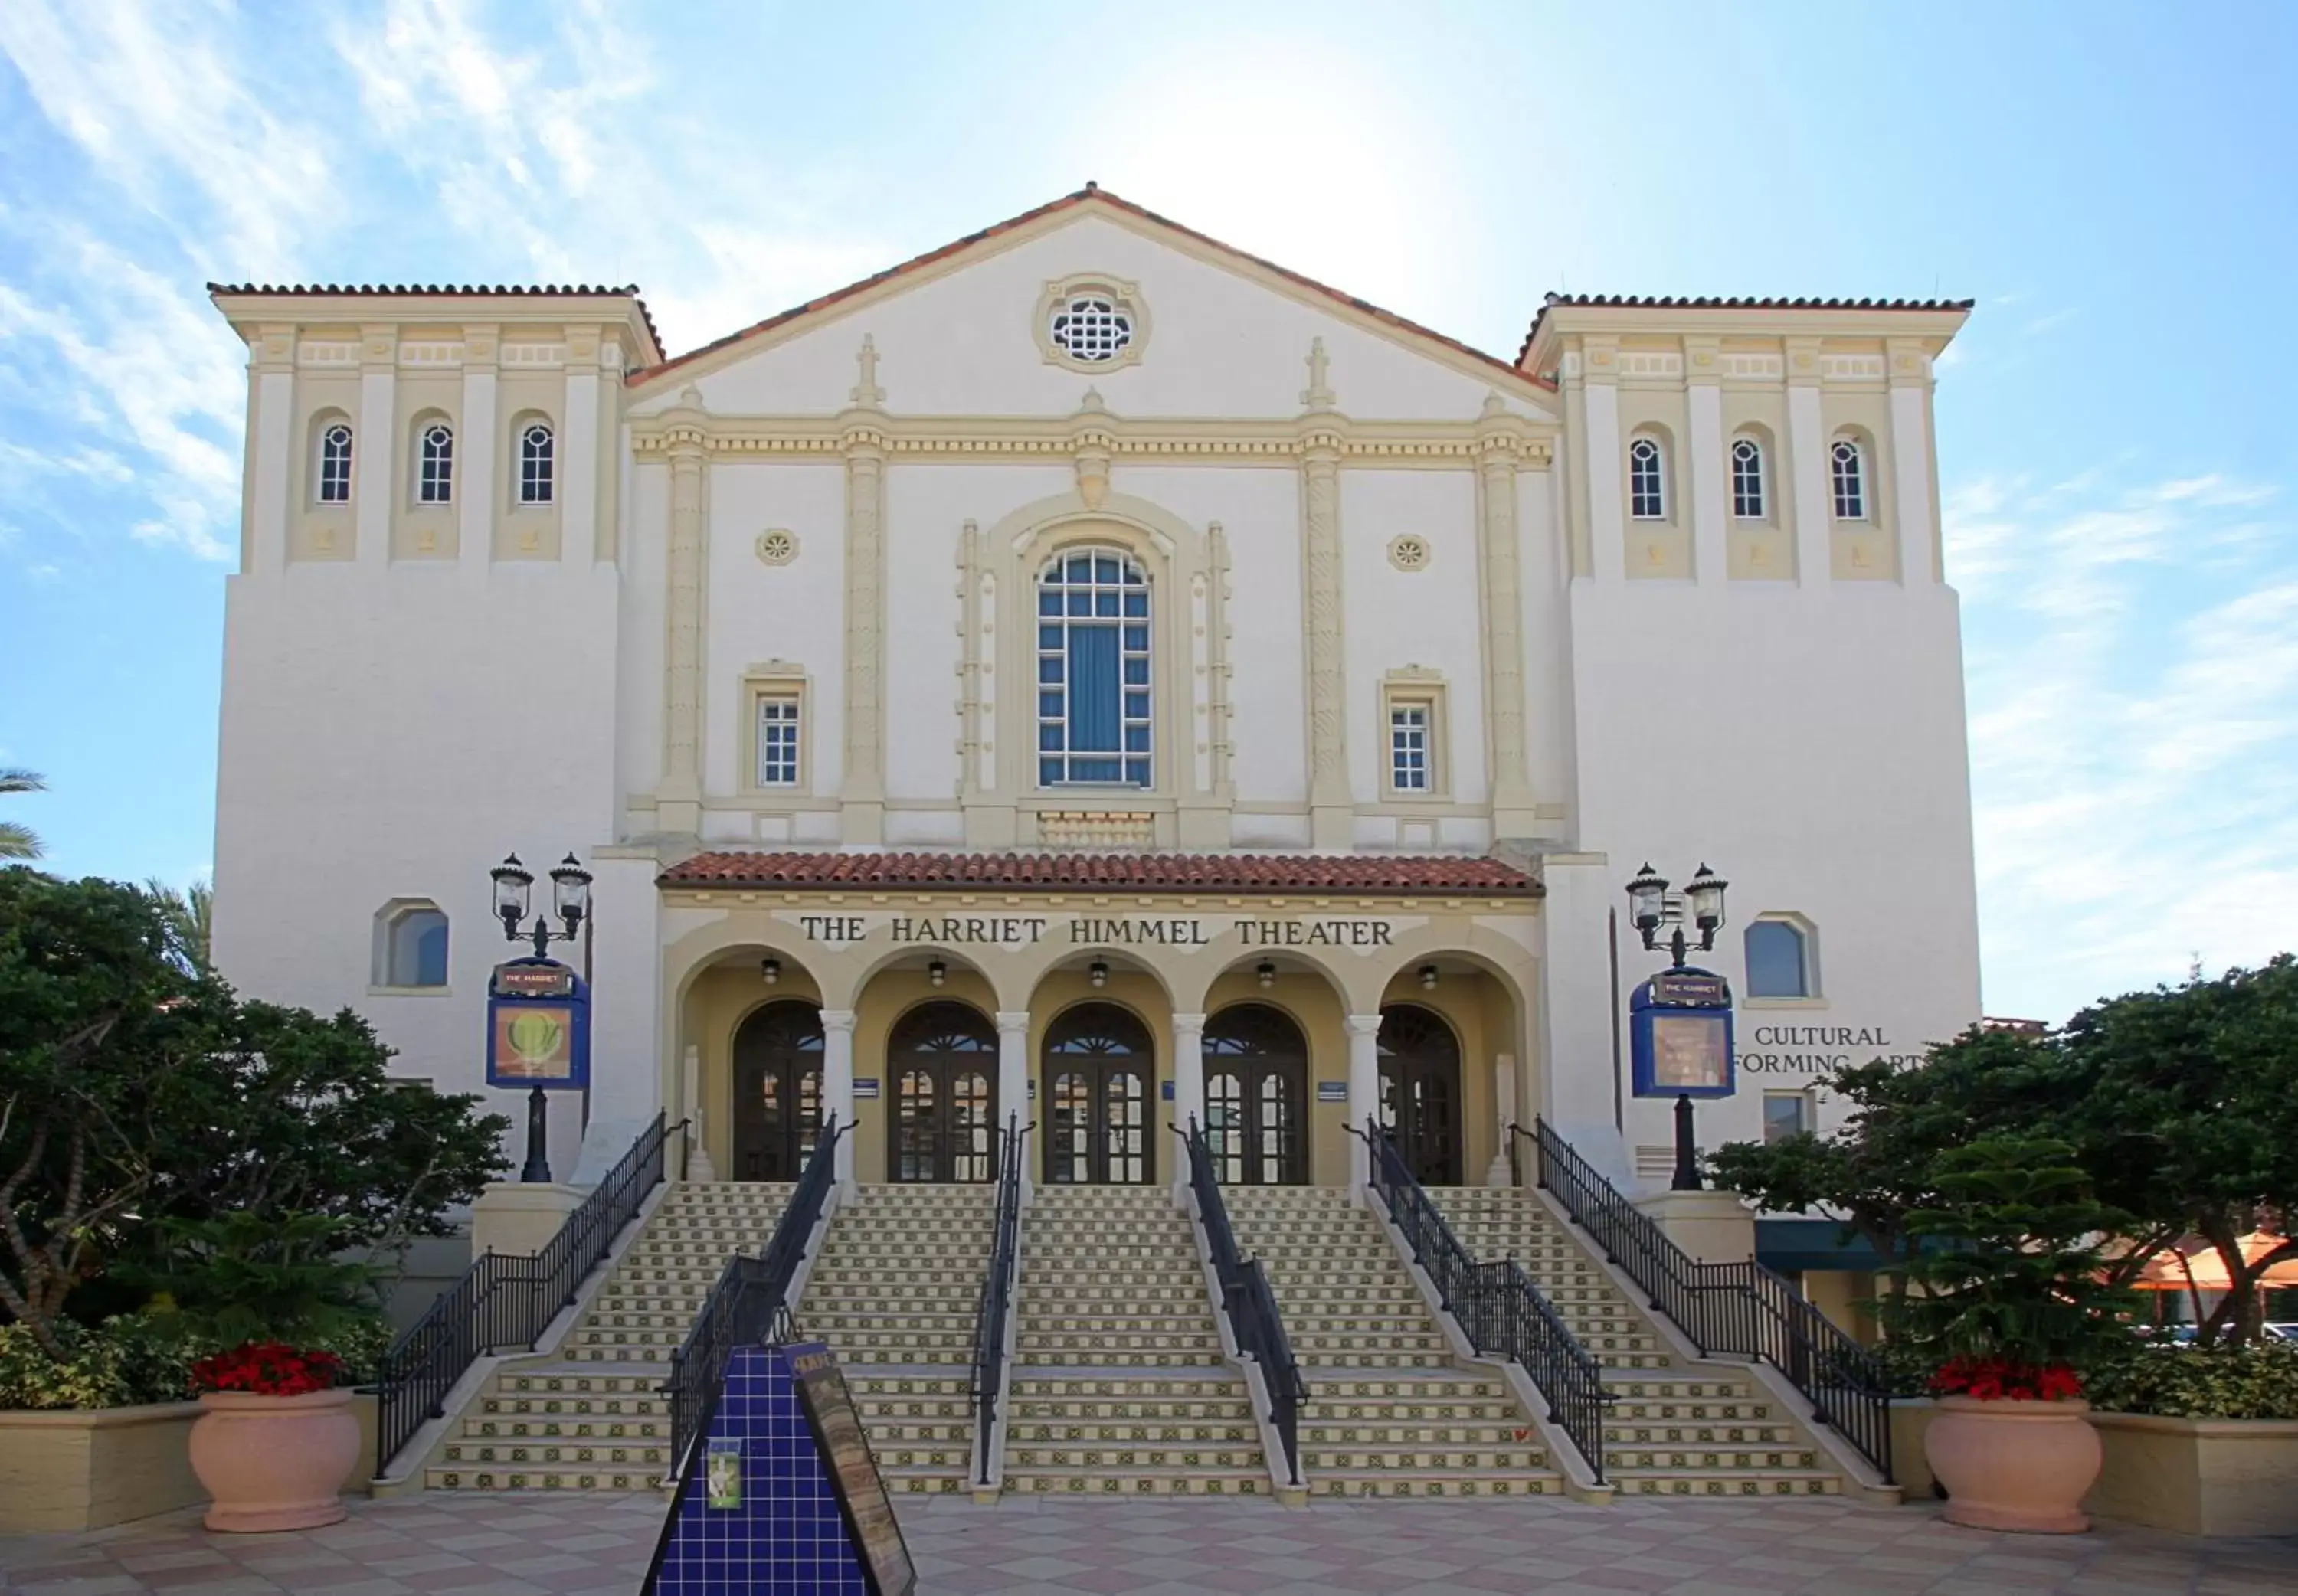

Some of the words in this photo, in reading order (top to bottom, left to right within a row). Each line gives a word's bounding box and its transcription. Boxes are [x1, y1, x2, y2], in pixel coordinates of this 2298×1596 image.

[800, 917, 866, 941] THE
[892, 917, 1046, 943] HARRIET
[1070, 919, 1210, 944] HIMMEL
[1234, 921, 1394, 946] THEATER
[1754, 1026, 1890, 1046] CULTURAL
[1874, 1055, 1929, 1074] RT
